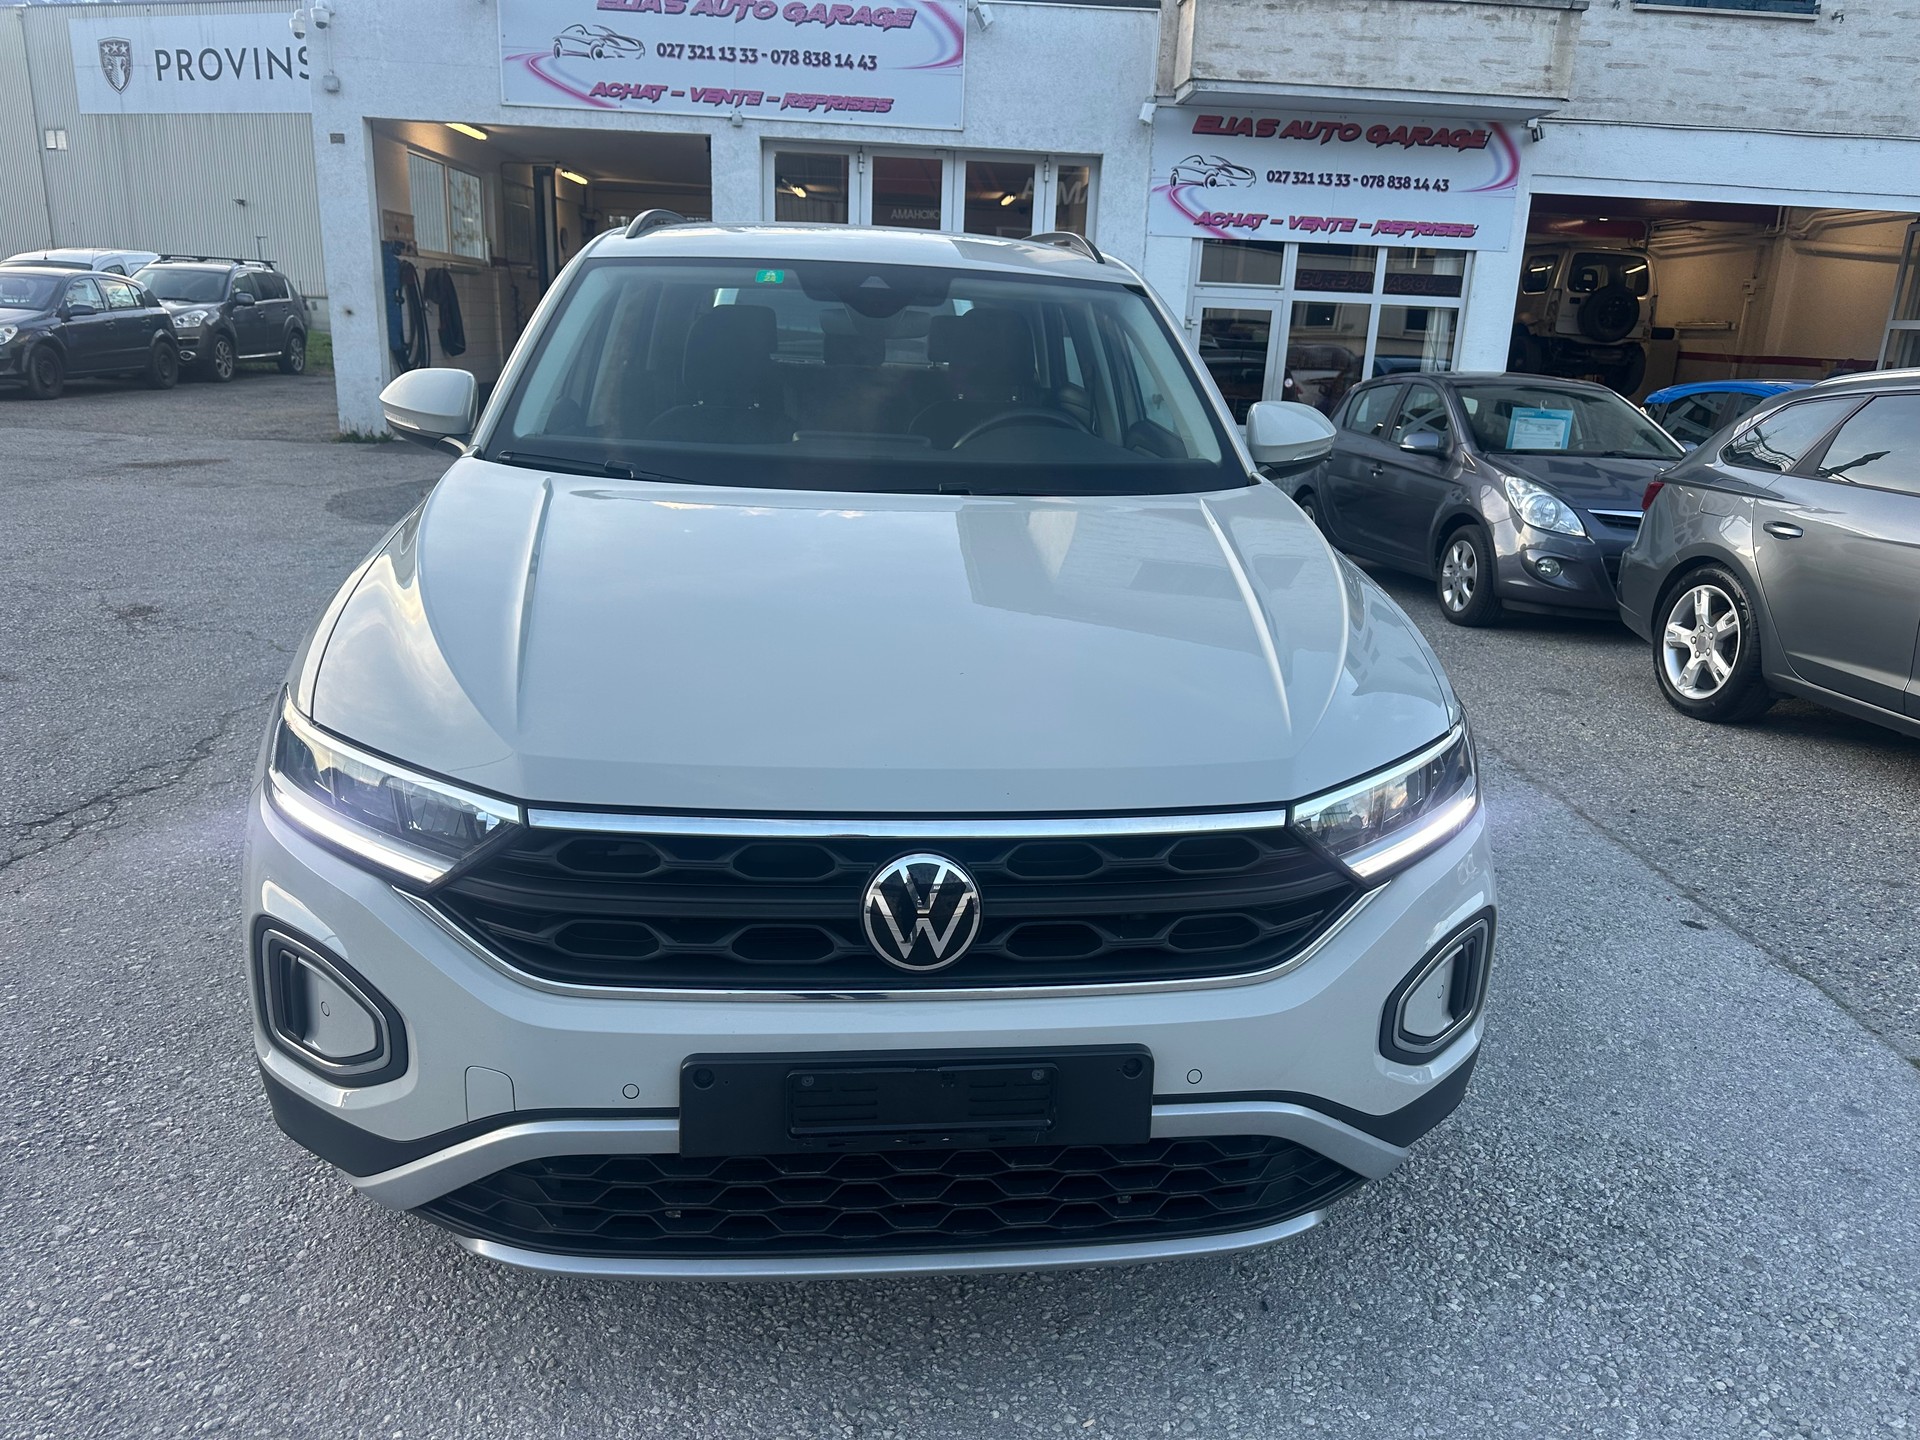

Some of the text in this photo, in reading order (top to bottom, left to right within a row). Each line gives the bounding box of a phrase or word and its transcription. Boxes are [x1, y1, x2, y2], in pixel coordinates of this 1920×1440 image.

[690, 0, 778, 23] AUTO
[782, 2, 917, 32] GARAGE
[154, 46, 310, 81] PROVINS
[656, 43, 685, 60] 027
[687, 45, 715, 60] 321
[718, 47, 737, 62] 13
[739, 48, 759, 64] 33
[770, 49, 800, 66] 078
[802, 50, 831, 68] 838
[834, 54, 854, 70] 14
[857, 55, 878, 71] 43
[589, 81, 668, 103] ACHAT
[690, 87, 764, 108] VENTE
[780, 92, 894, 113] REPRISES
[1192, 115, 1492, 152] ELIAS AUTO GARAGE
[1266, 170, 1290, 184] 027
[1292, 171, 1315, 185] 321
[1318, 173, 1333, 187] 13
[1335, 174, 1351, 188] 33
[1360, 174, 1385, 189] 078
[1387, 175, 1411, 190] 838
[1414, 178, 1430, 192] 14
[1432, 179, 1450, 193] 43
[1194, 211, 1268, 231] ACHAT
[1288, 215, 1357, 235] VENTE
[1372, 219, 1479, 239] REPRISES
[1300, 271, 1459, 295] BUREAU ACCU
[865, 854, 979, 964] VW
